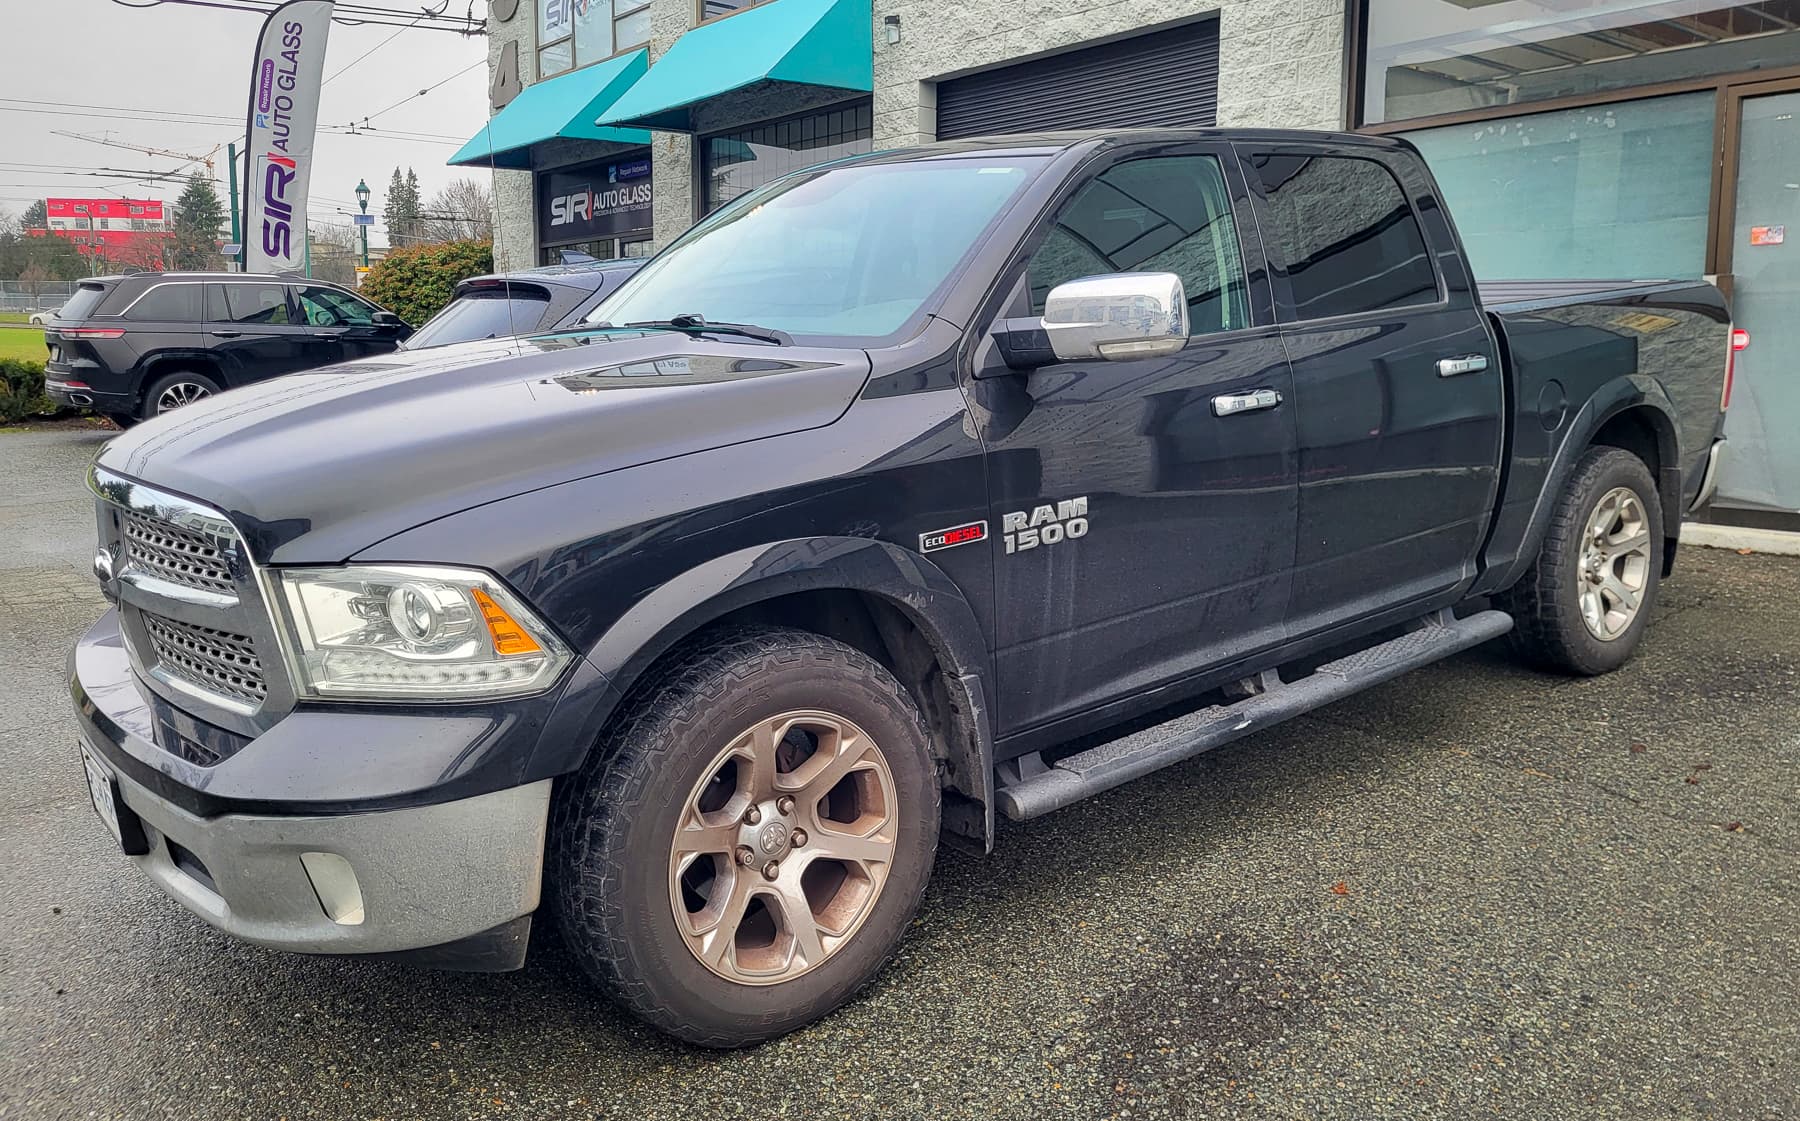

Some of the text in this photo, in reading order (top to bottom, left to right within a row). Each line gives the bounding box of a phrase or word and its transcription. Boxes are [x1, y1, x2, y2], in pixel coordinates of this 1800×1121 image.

[277, 21, 302, 91] GLASS
[263, 63, 272, 88] Network
[261, 89, 269, 109] Repair
[272, 95, 293, 153] AUTO
[593, 190, 618, 210] AUTO
[619, 183, 652, 206] GLASS
[1003, 496, 1088, 533] RAM
[1004, 518, 1089, 554] 1500
